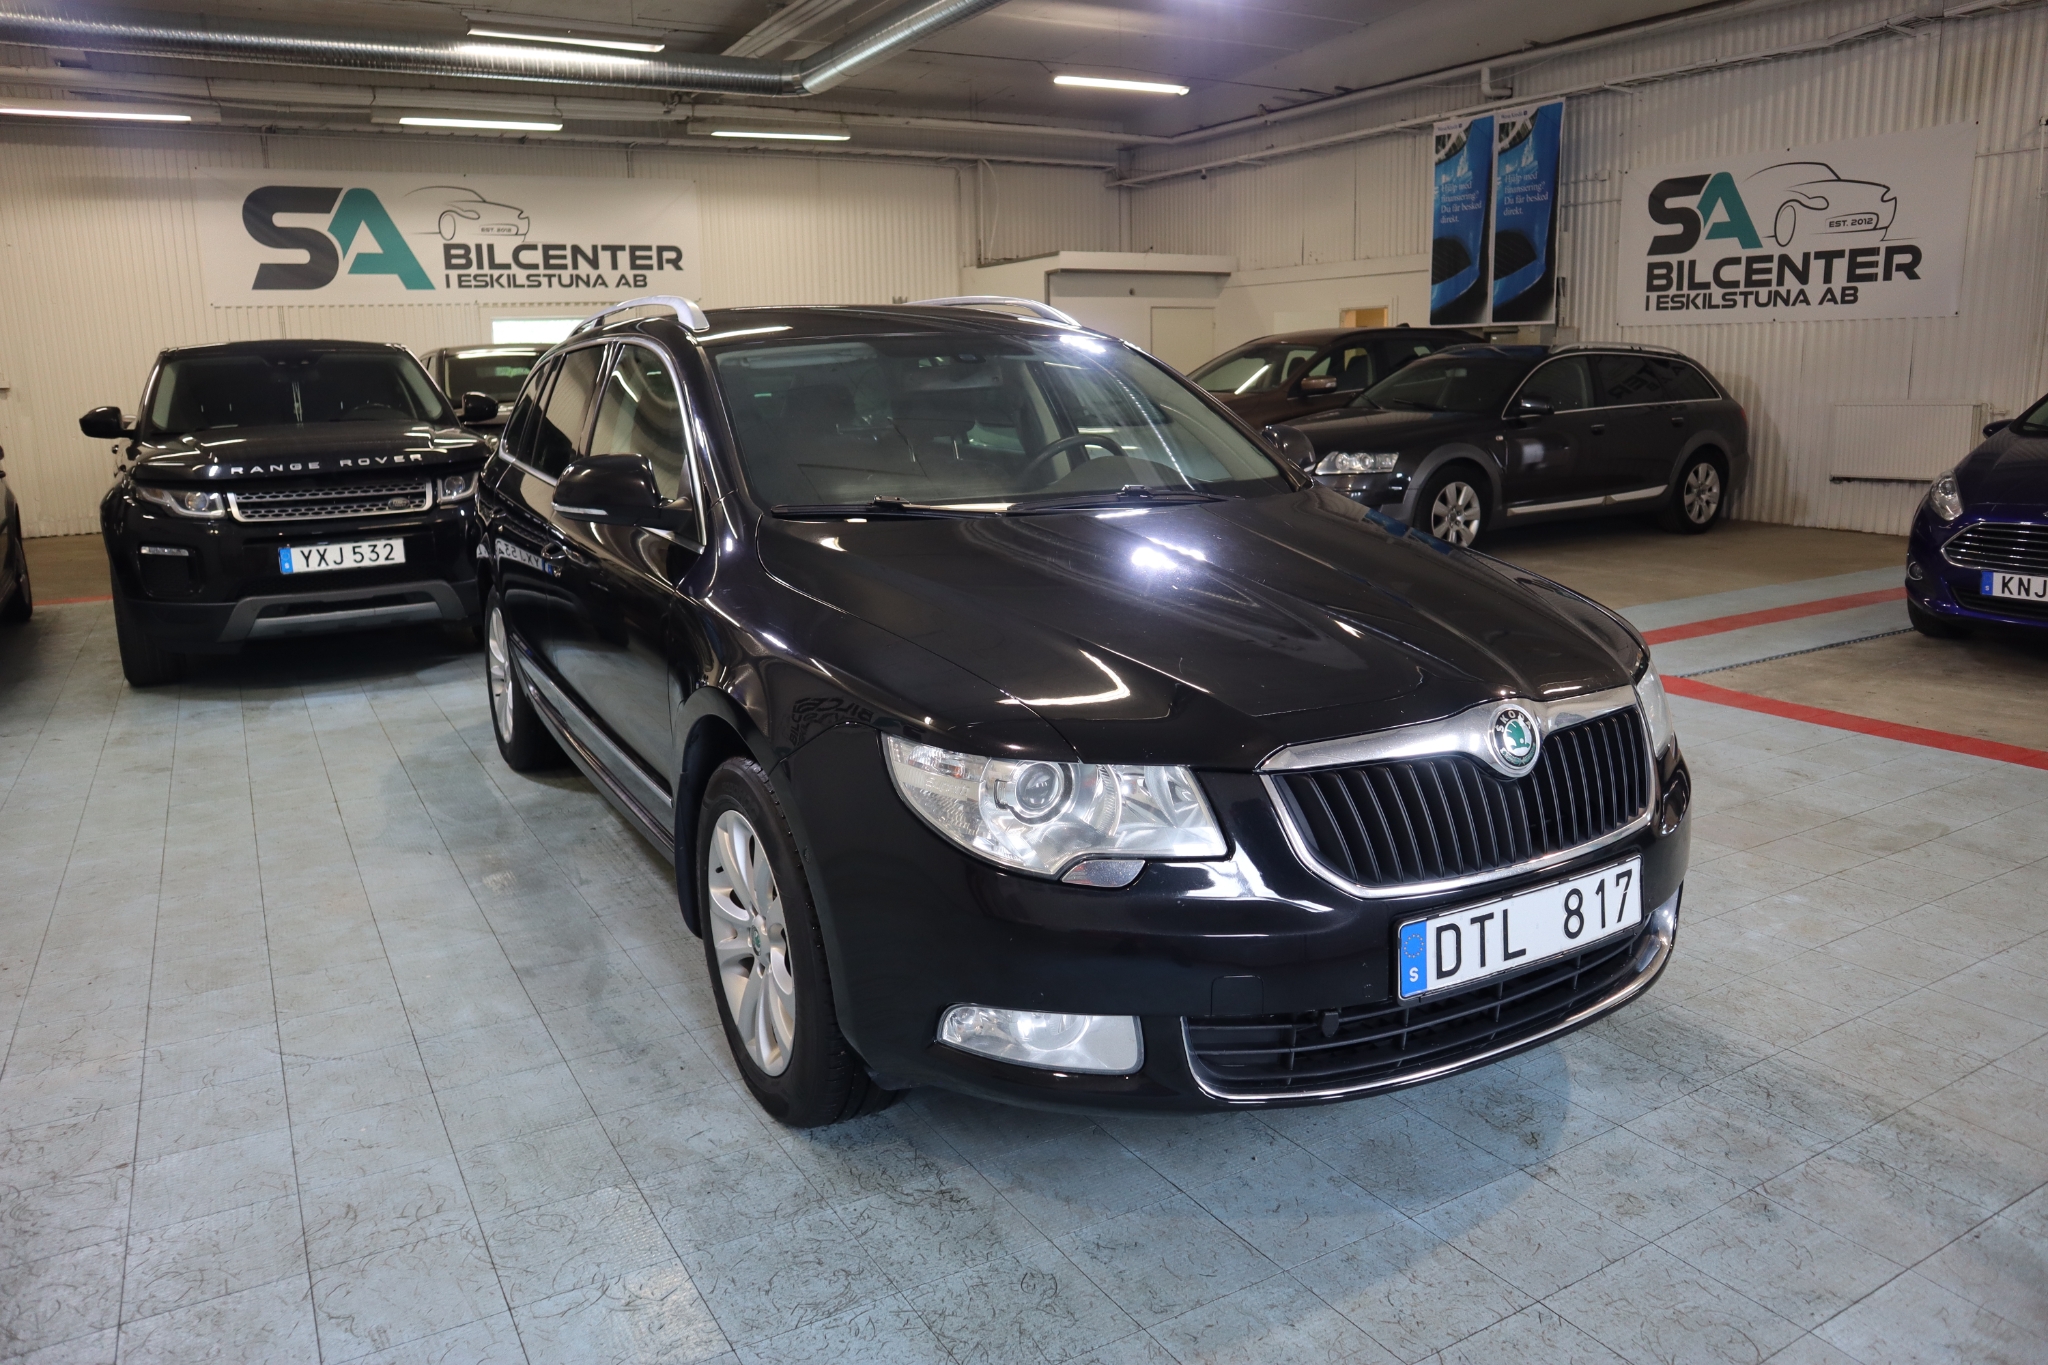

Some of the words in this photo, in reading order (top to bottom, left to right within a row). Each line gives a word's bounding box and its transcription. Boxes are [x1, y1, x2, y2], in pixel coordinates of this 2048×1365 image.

[1459, 181, 1472, 189] med
[1505, 174, 1521, 183] Hjälp
[1523, 171, 1538, 180] med
[1441, 204, 1451, 213] Du
[1504, 196, 1514, 205] Du
[1526, 192, 1549, 202] besked
[1647, 171, 1763, 256] SA
[1829, 219, 1849, 228] EST.
[1851, 217, 1874, 226] 2012
[242, 185, 436, 290] SA
[443, 243, 684, 271] BILCENTER
[1646, 244, 1922, 293] BILCENTER
[445, 274, 451, 288] I
[457, 273, 609, 289] ESKILSTUNA
[615, 274, 648, 288] AB
[1645, 295, 1650, 311] I
[1656, 287, 1812, 311] ESKILSTUNA
[1818, 286, 1859, 306] AB
[231, 461, 320, 475] RANGE
[340, 453, 423, 467] ROVER
[300, 546, 344, 568] YXJ
[353, 543, 396, 564] 532
[2001, 575, 2048, 598] KNJ
[1436, 909, 1527, 980] DTL
[1564, 868, 1633, 940] 817
[1408, 967, 1419, 983] S
